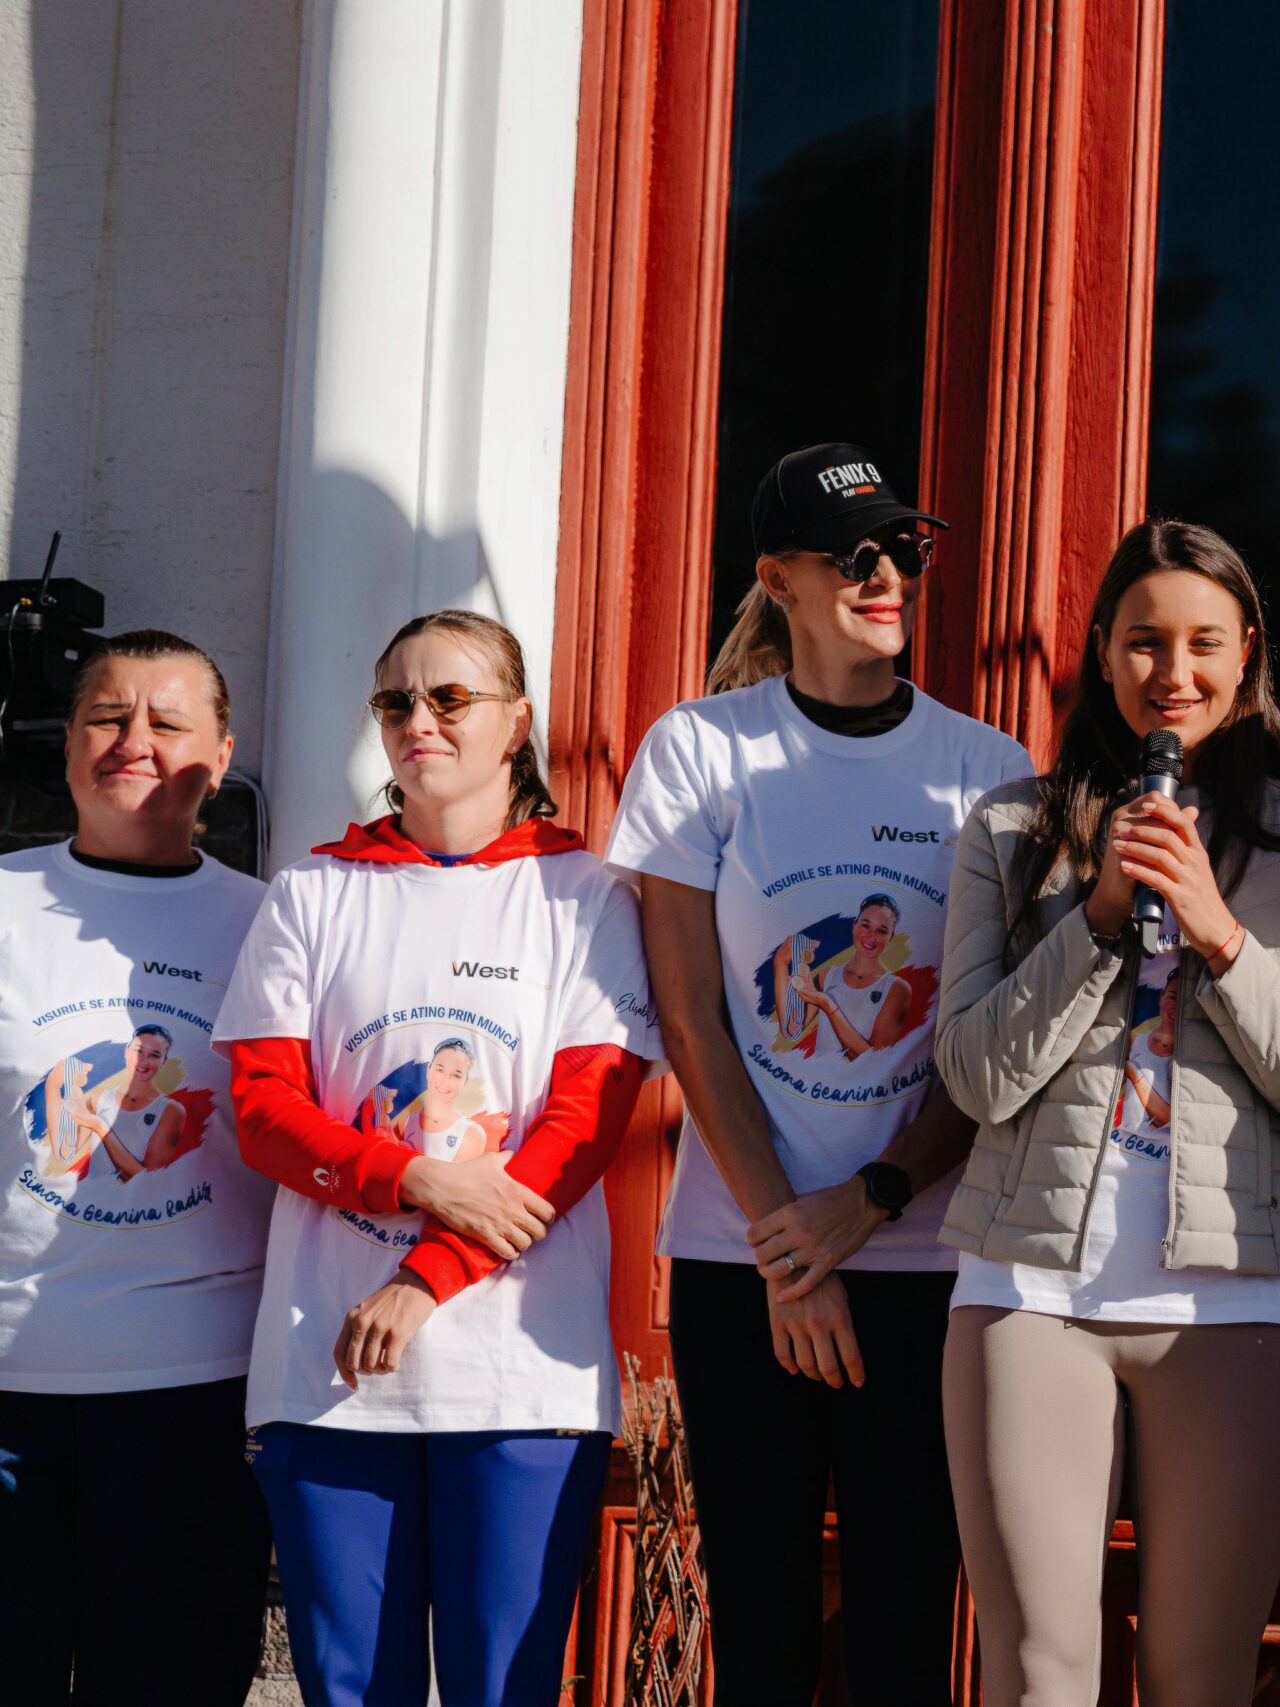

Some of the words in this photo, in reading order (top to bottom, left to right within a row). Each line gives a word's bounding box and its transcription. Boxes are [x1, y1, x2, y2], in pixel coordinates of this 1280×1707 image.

[866, 462, 882, 483] 9
[871, 825, 939, 843] West
[762, 868, 816, 898] VISURILE
[818, 864, 832, 877] SE
[835, 864, 871, 875] ATING
[873, 865, 901, 883] PRIN
[902, 874, 947, 907] MUNCĂ
[143, 960, 203, 982] West
[452, 960, 519, 981] West
[33, 1001, 86, 1027] VISURILE
[90, 998, 105, 1009] SE
[108, 998, 144, 1009] ATING
[147, 1001, 176, 1015] PRIN
[345, 1014, 390, 1053] VISURILE
[393, 1010, 407, 1023] SE
[411, 1007, 445, 1019] ATING
[448, 1008, 476, 1024] PRIN
[477, 1016, 520, 1051] MUNCĂ
[748, 1044, 807, 1094] Simona
[811, 1082, 888, 1101] Geanina
[19, 1169, 80, 1217] Simona
[83, 1204, 162, 1224] Geanina
